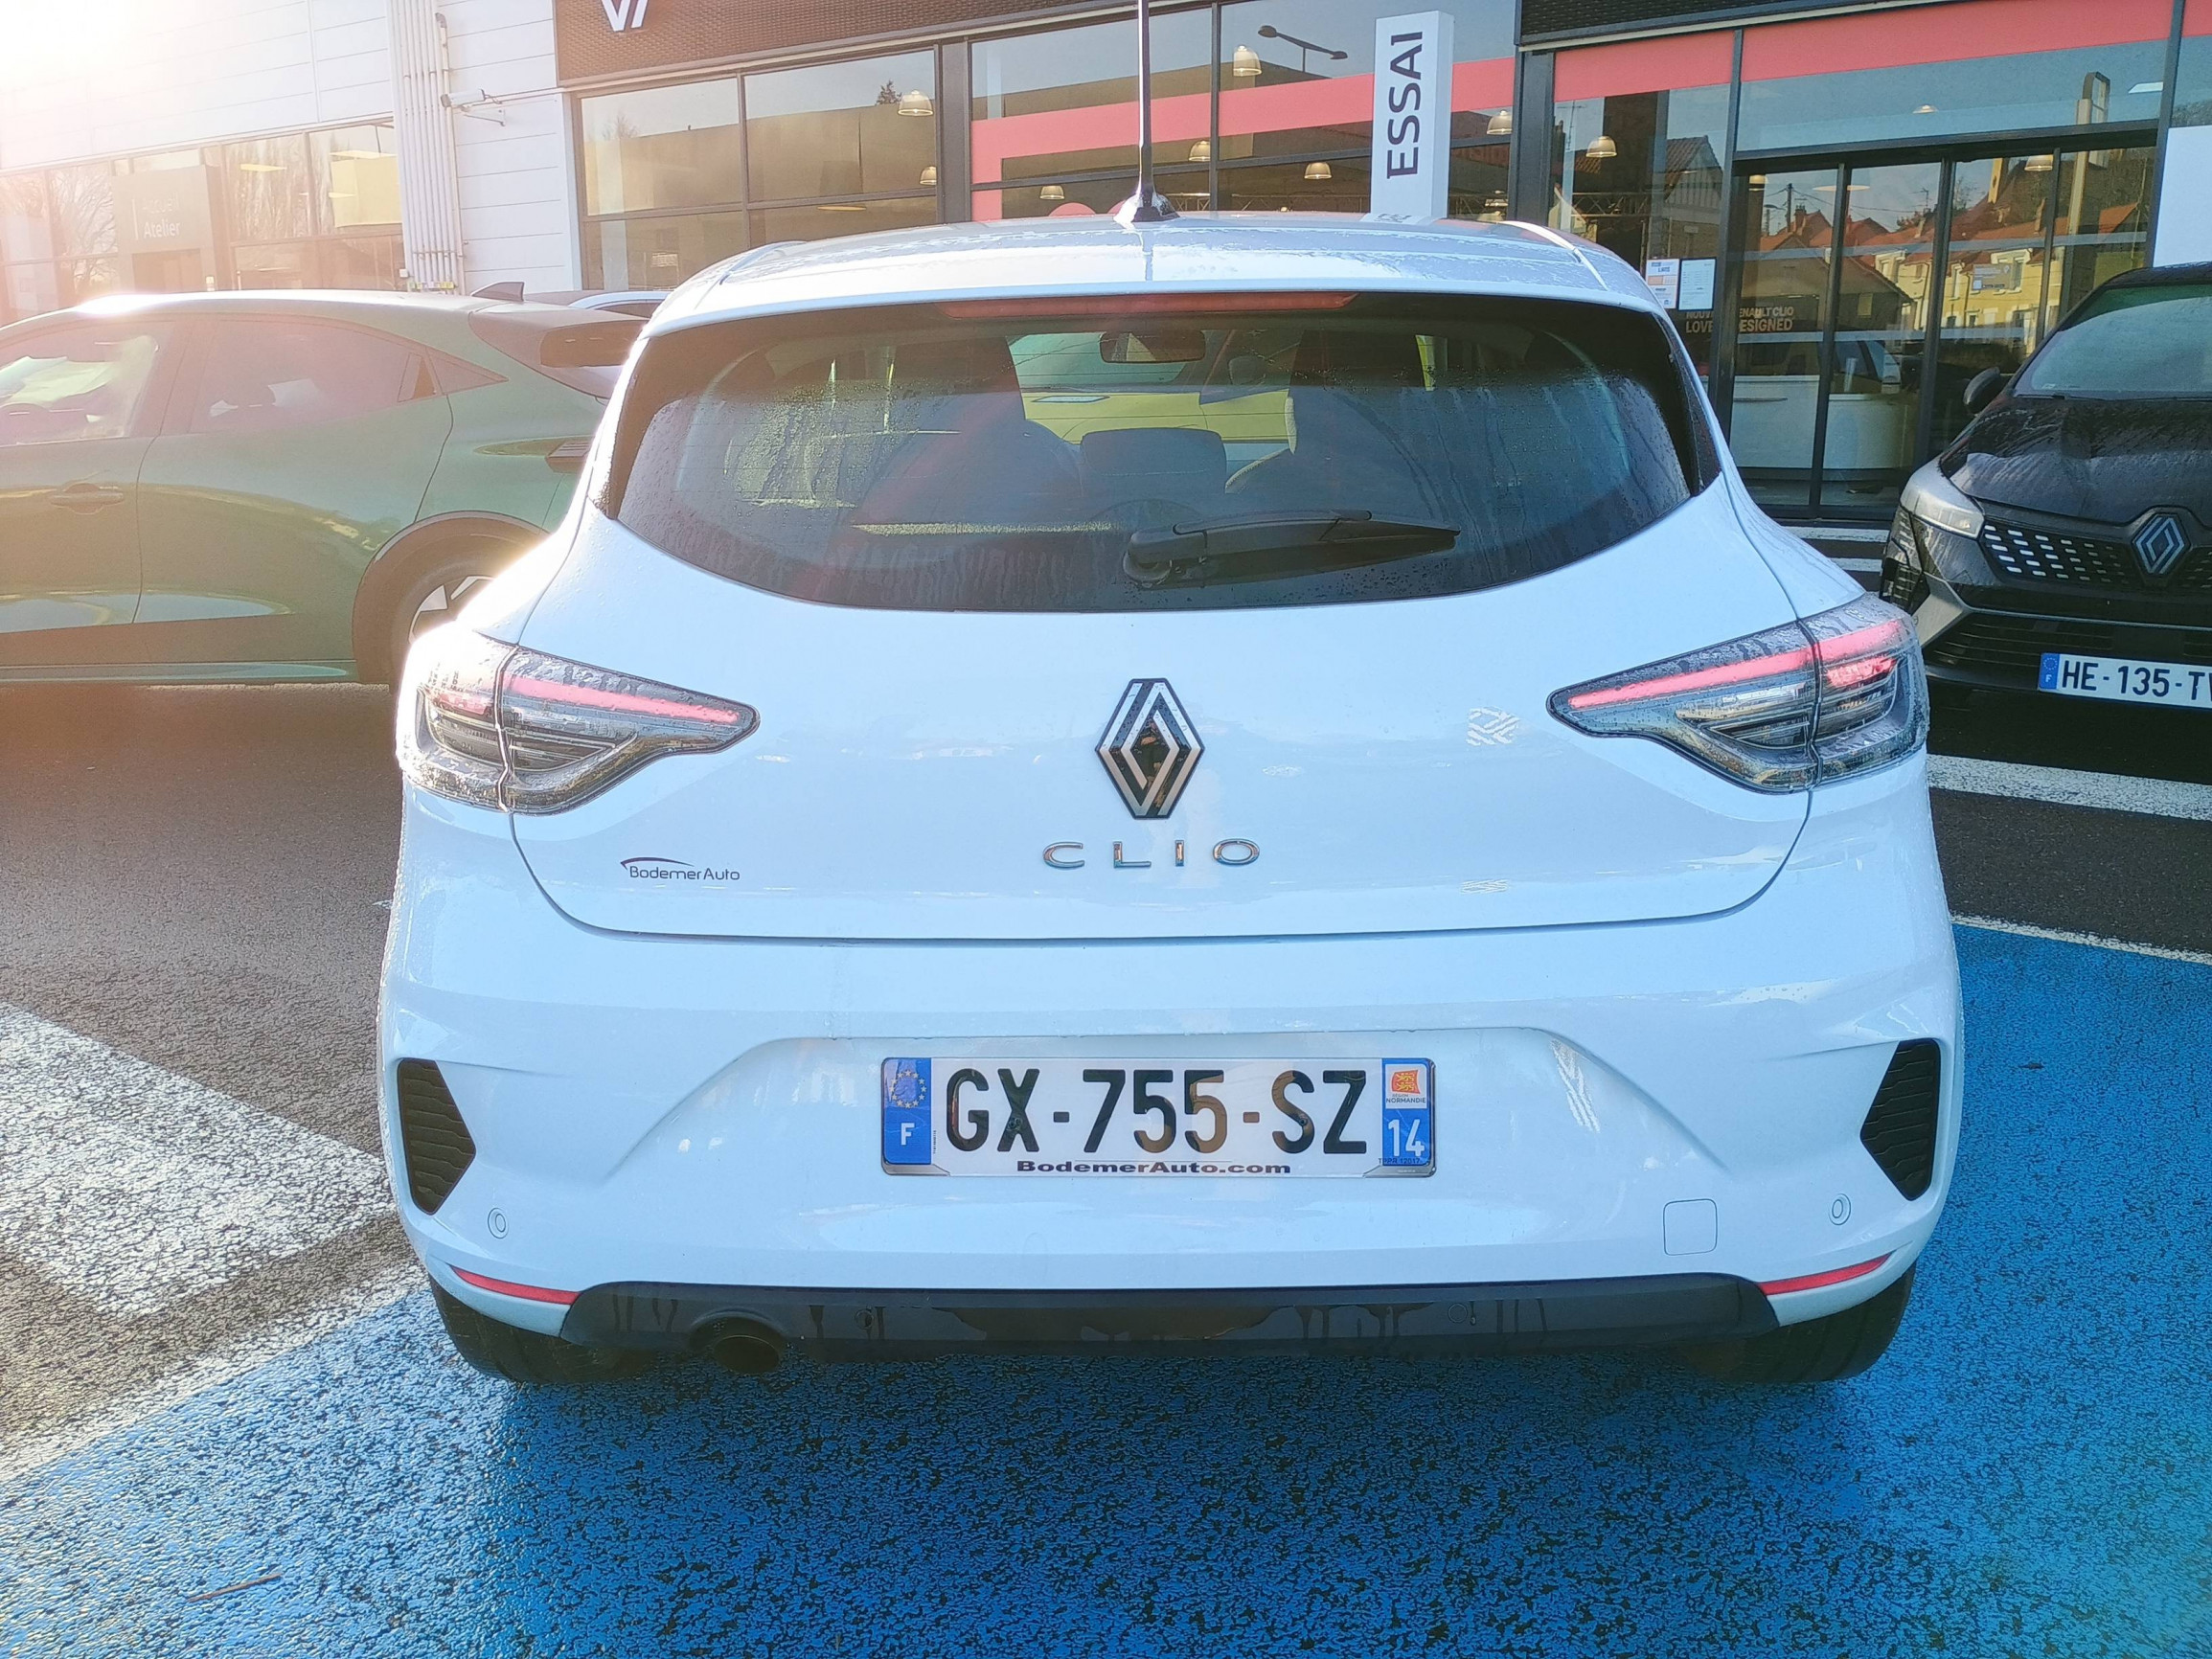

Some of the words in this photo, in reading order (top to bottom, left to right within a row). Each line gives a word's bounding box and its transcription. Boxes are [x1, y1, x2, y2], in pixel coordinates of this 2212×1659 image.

[1387, 32, 1424, 180] ESSAI
[143, 218, 181, 239] Atelier
[1739, 307, 1772, 319] ENAULT
[1772, 306, 1794, 317] CLIO
[1685, 320, 1713, 333] LOVE
[1739, 317, 1793, 332] ESIGNED
[2044, 673, 2052, 683] F
[2062, 660, 2212, 701] HE-135-T
[1043, 838, 1260, 869] CLIO
[629, 865, 741, 880] BodemerAuto
[946, 1068, 1367, 1154] GX-755-SZ
[901, 1122, 915, 1146] F
[1388, 1119, 1425, 1157] 14
[1016, 1160, 1291, 1174] BodemerAuto.com
